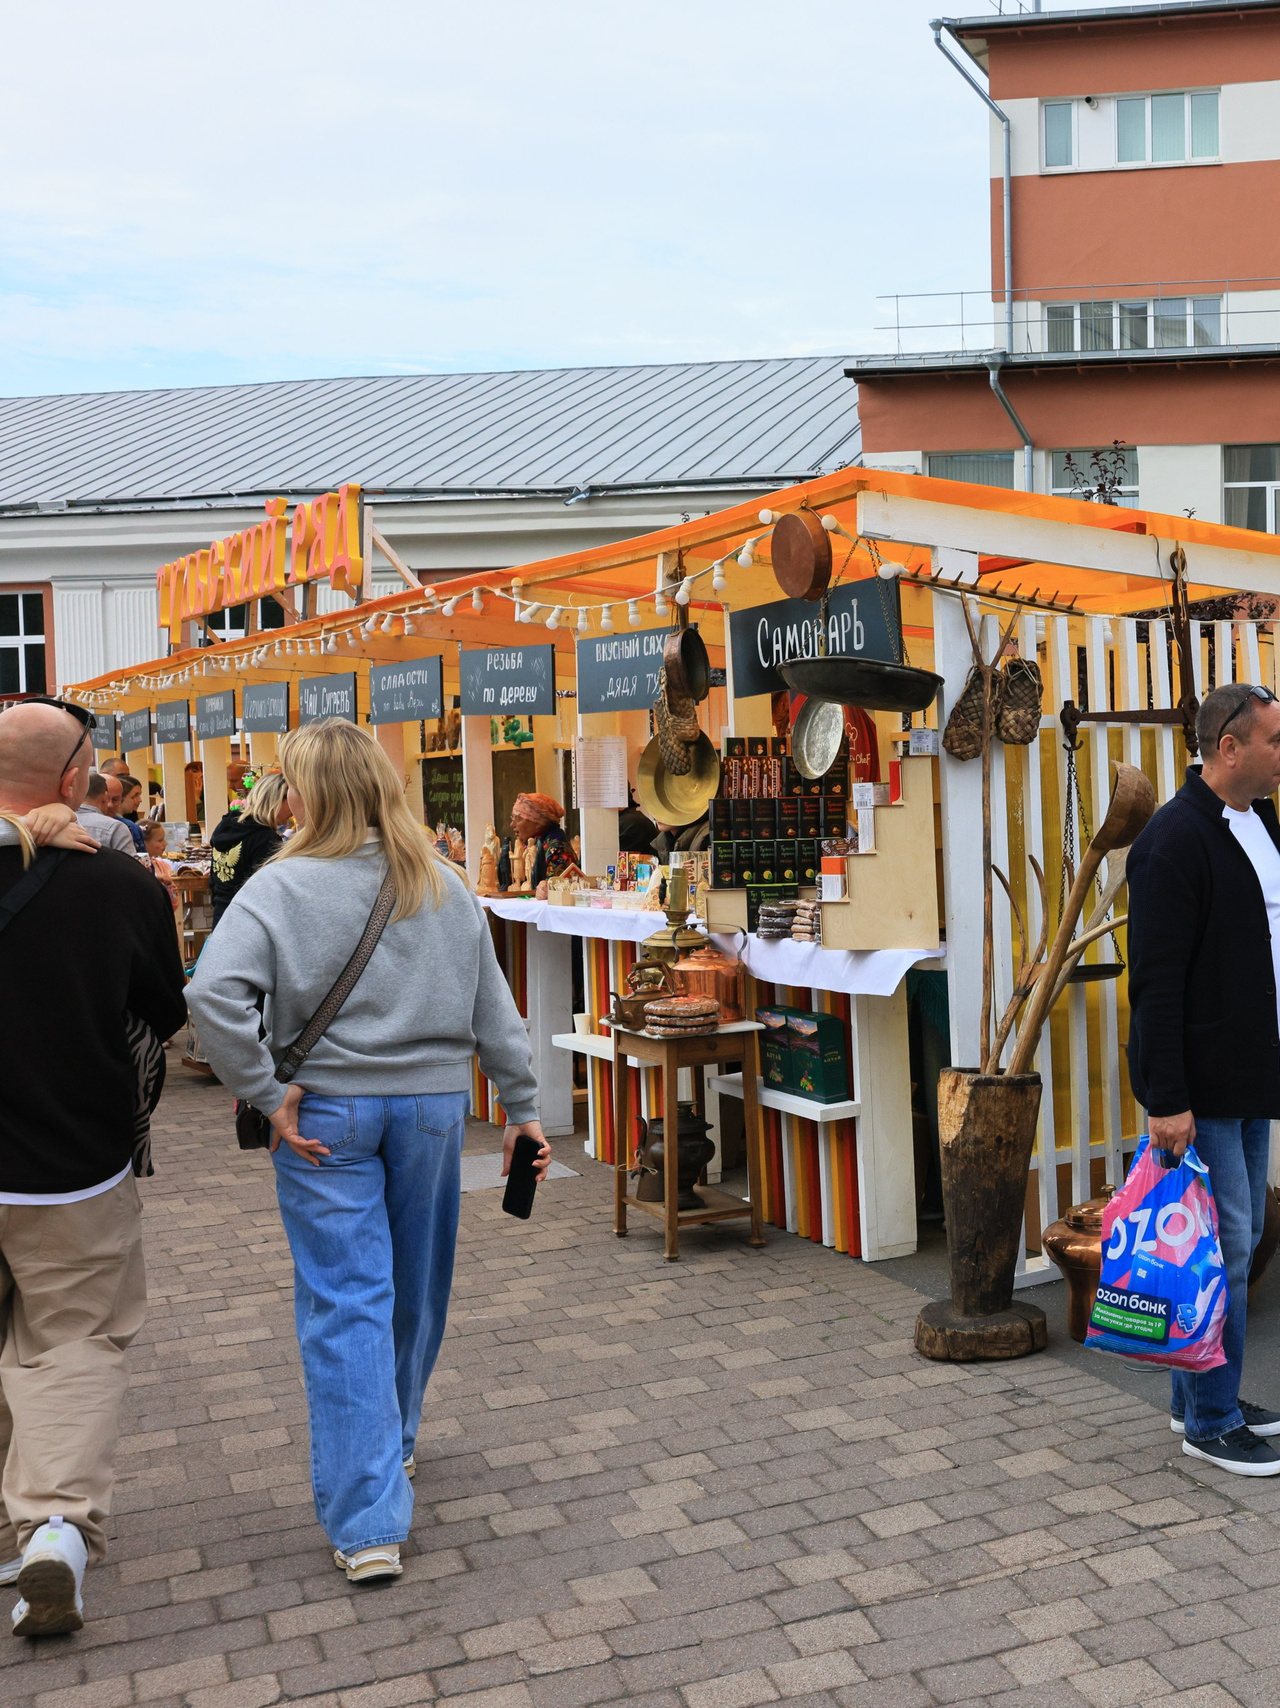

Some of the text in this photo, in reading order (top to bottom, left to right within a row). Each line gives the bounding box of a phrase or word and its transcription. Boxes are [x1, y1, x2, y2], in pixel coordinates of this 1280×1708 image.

[156, 483, 363, 645] ТУЛЬСКИЙ РЯД
[595, 633, 670, 663] ВКУСНЫЙ САХ
[381, 669, 429, 692] СЛАДОСТИ
[304, 685, 318, 717] ЧАЙ
[483, 686, 538, 706] ПО ДЕРЕВУ
